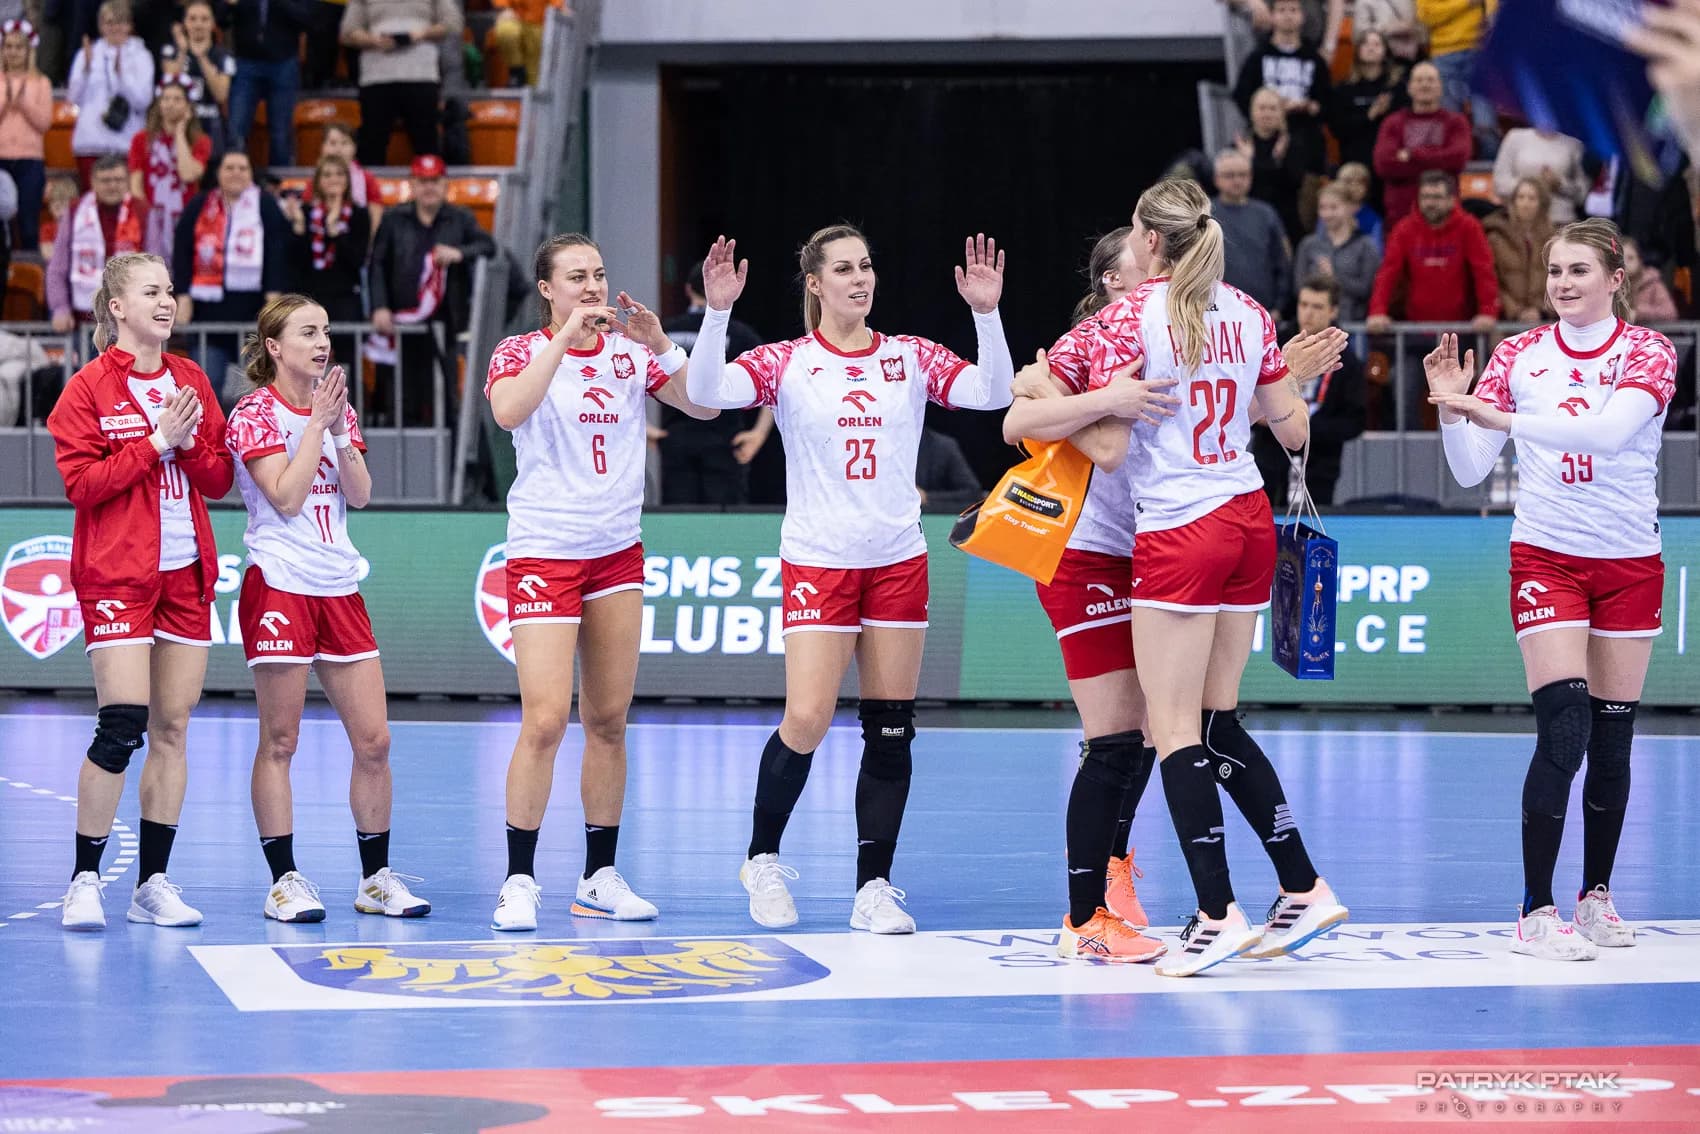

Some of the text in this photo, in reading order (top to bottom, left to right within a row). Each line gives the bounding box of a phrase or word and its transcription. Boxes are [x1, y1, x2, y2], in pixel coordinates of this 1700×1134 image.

[578, 412, 619, 424] ORLEN
[837, 416, 882, 428] ORLEN
[1189, 378, 1238, 465] 22
[591, 433, 608, 475] 6
[845, 438, 877, 481] 23
[309, 483, 338, 495] RLEN
[313, 504, 335, 544] 11
[643, 556, 742, 599] SMS
[1337, 564, 1430, 603] PRP
[514, 601, 553, 615] ORLEN
[786, 608, 821, 622] ORLEN
[1085, 597, 1132, 616] ORLEN
[1517, 606, 1556, 625] ORLEN
[93, 621, 130, 637] ORLEN
[256, 639, 293, 652] ORLEN
[881, 726, 905, 734] SELECT
